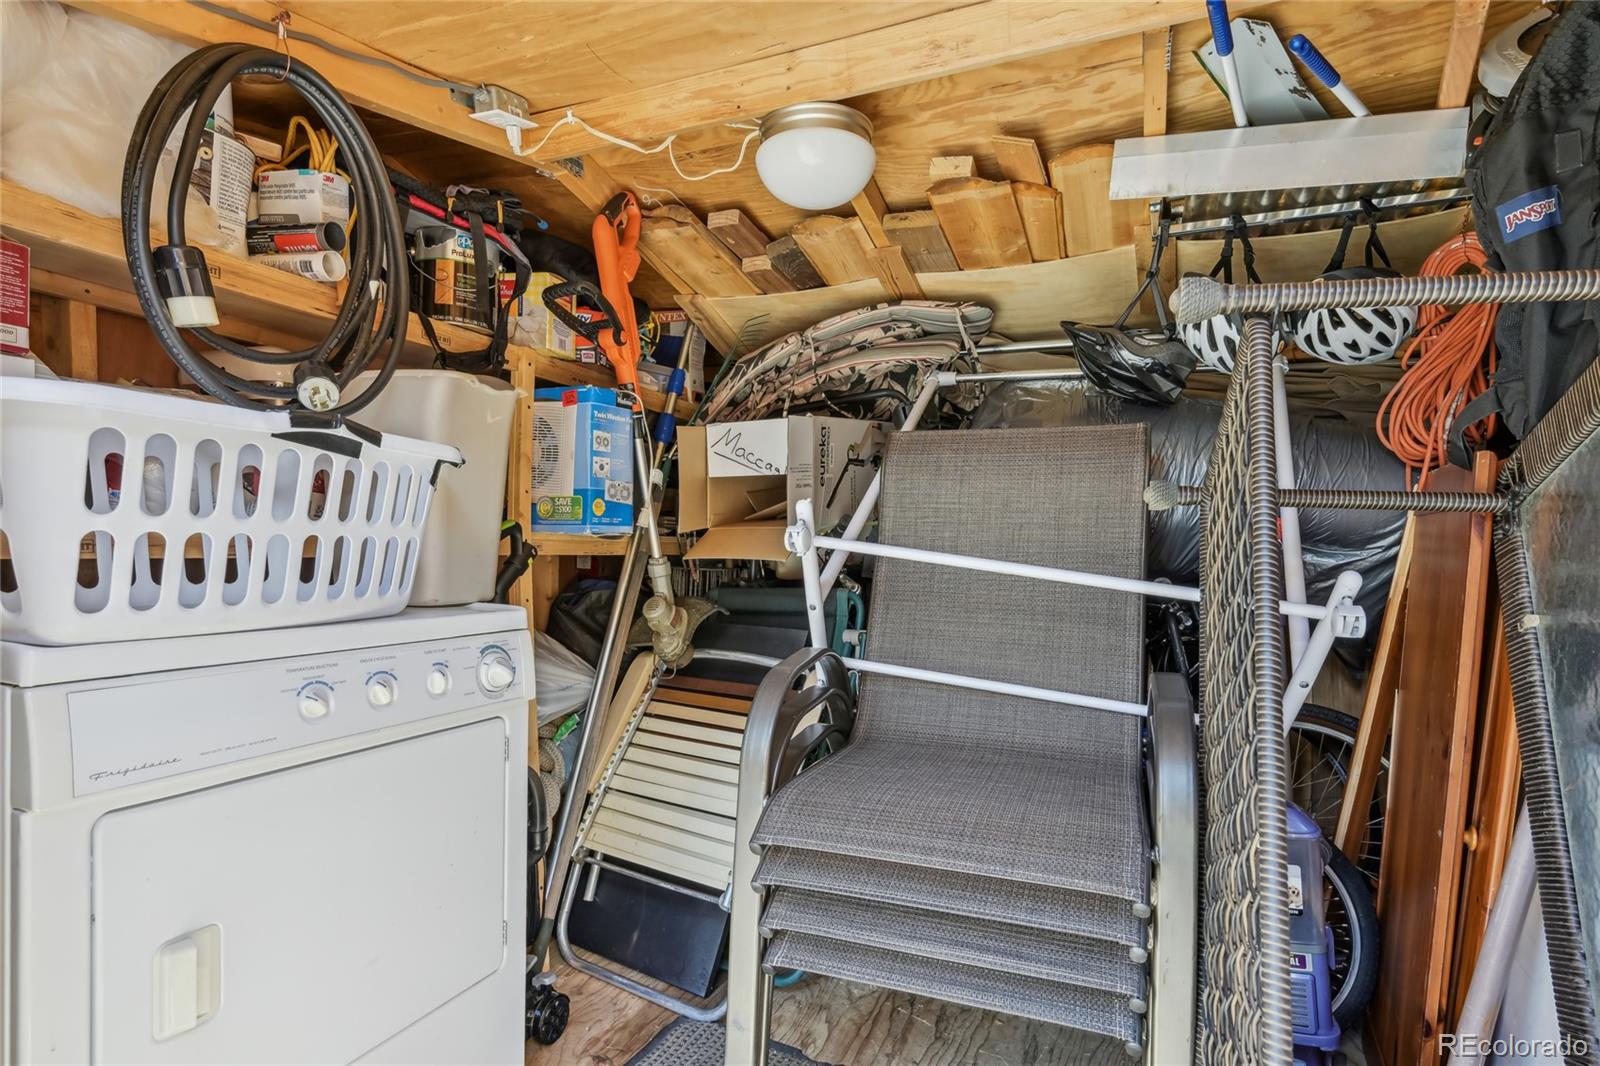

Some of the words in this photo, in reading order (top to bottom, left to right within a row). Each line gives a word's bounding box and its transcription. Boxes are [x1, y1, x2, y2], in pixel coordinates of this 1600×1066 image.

[322, 174, 335, 184] 3M
[818, 426, 827, 488] eureka
[554, 497, 573, 506] SAVE
[88, 757, 182, 782] Frigidaire
